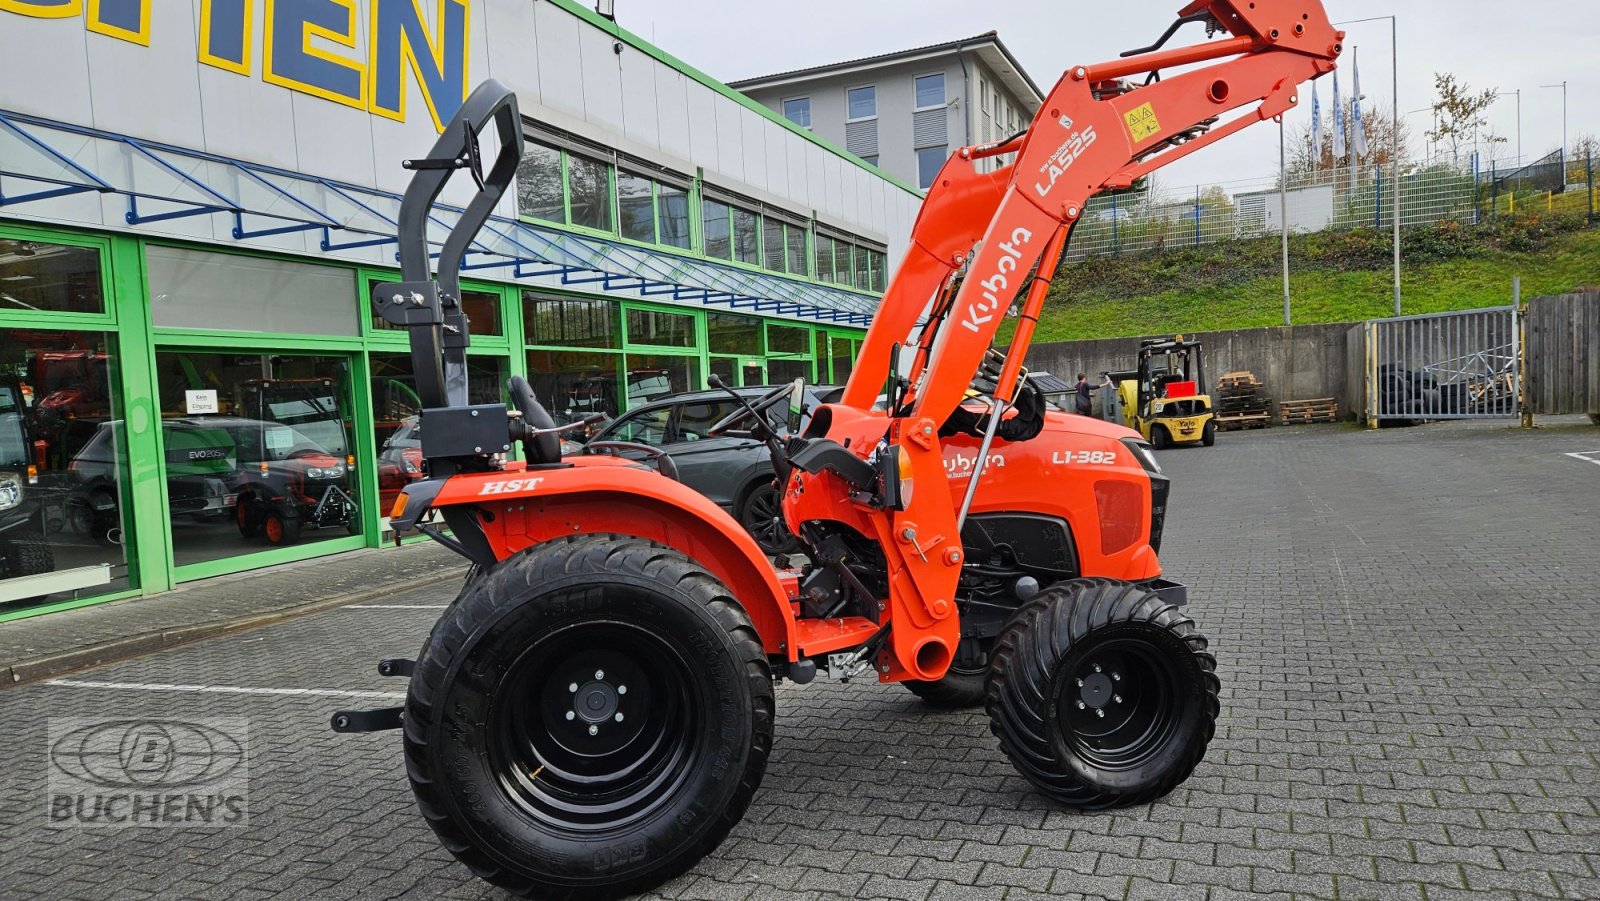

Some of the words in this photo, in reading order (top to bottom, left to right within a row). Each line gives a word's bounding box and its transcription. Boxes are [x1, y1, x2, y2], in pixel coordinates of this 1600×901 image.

[1035, 125, 1097, 197] LA525
[961, 227, 1033, 333] Kubota
[189, 450, 206, 459] EVO
[206, 449, 221, 458] 205
[1052, 450, 1117, 465] L1-382
[477, 477, 545, 496] HST
